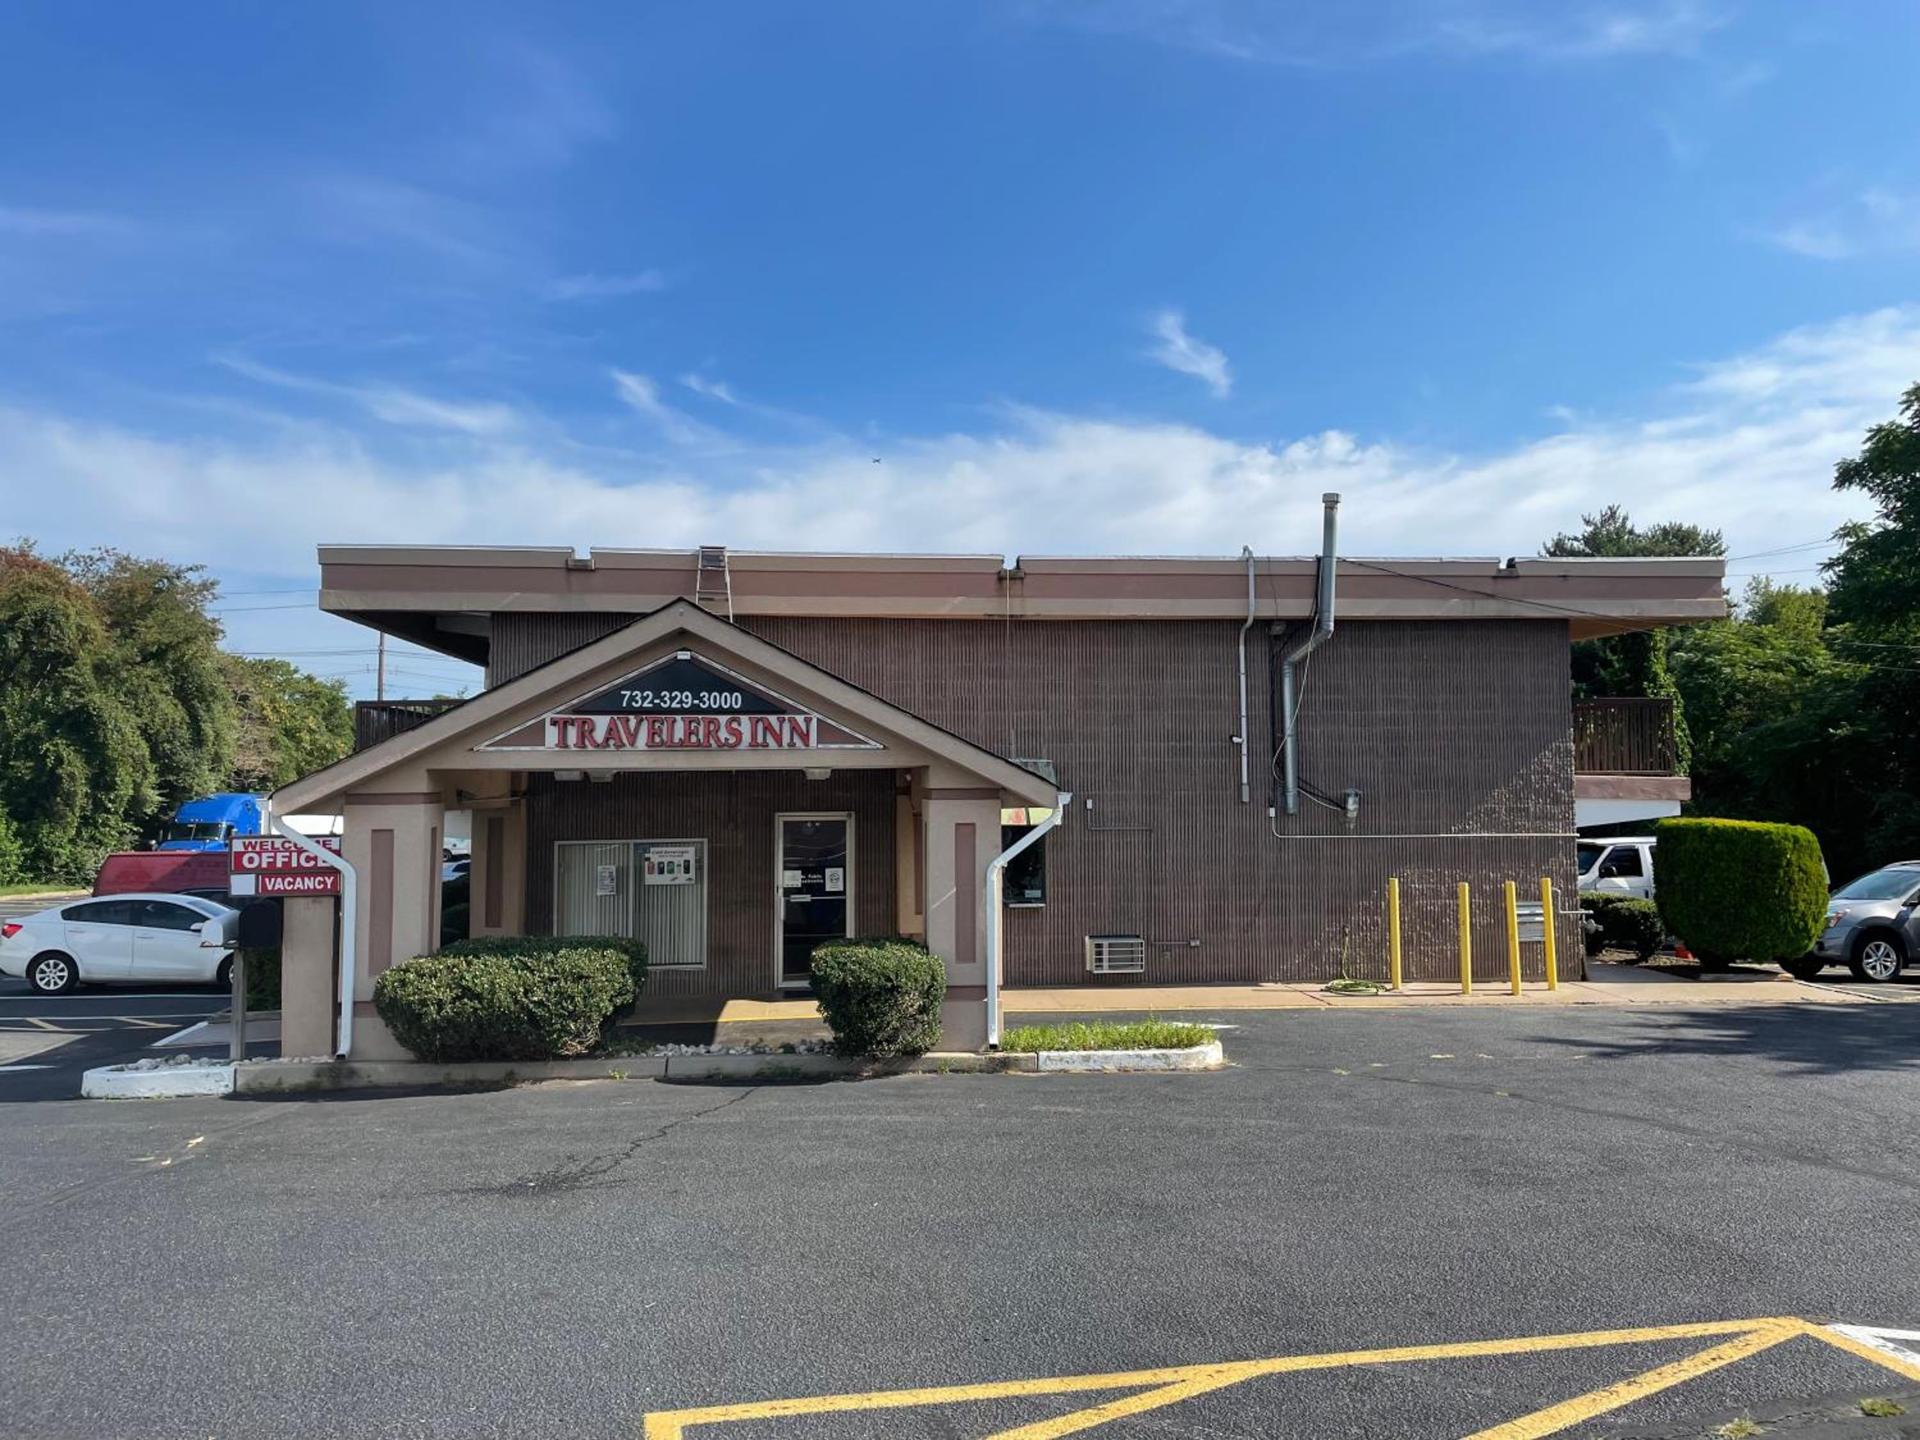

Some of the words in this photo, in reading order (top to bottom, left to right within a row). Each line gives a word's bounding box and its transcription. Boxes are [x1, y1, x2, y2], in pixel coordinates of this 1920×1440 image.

[620, 690, 742, 709] 732-329-3000
[550, 716, 743, 748] TRAVELERS
[748, 716, 813, 748] INN
[242, 840, 333, 851] WELCE
[264, 876, 335, 891] VACANCY
